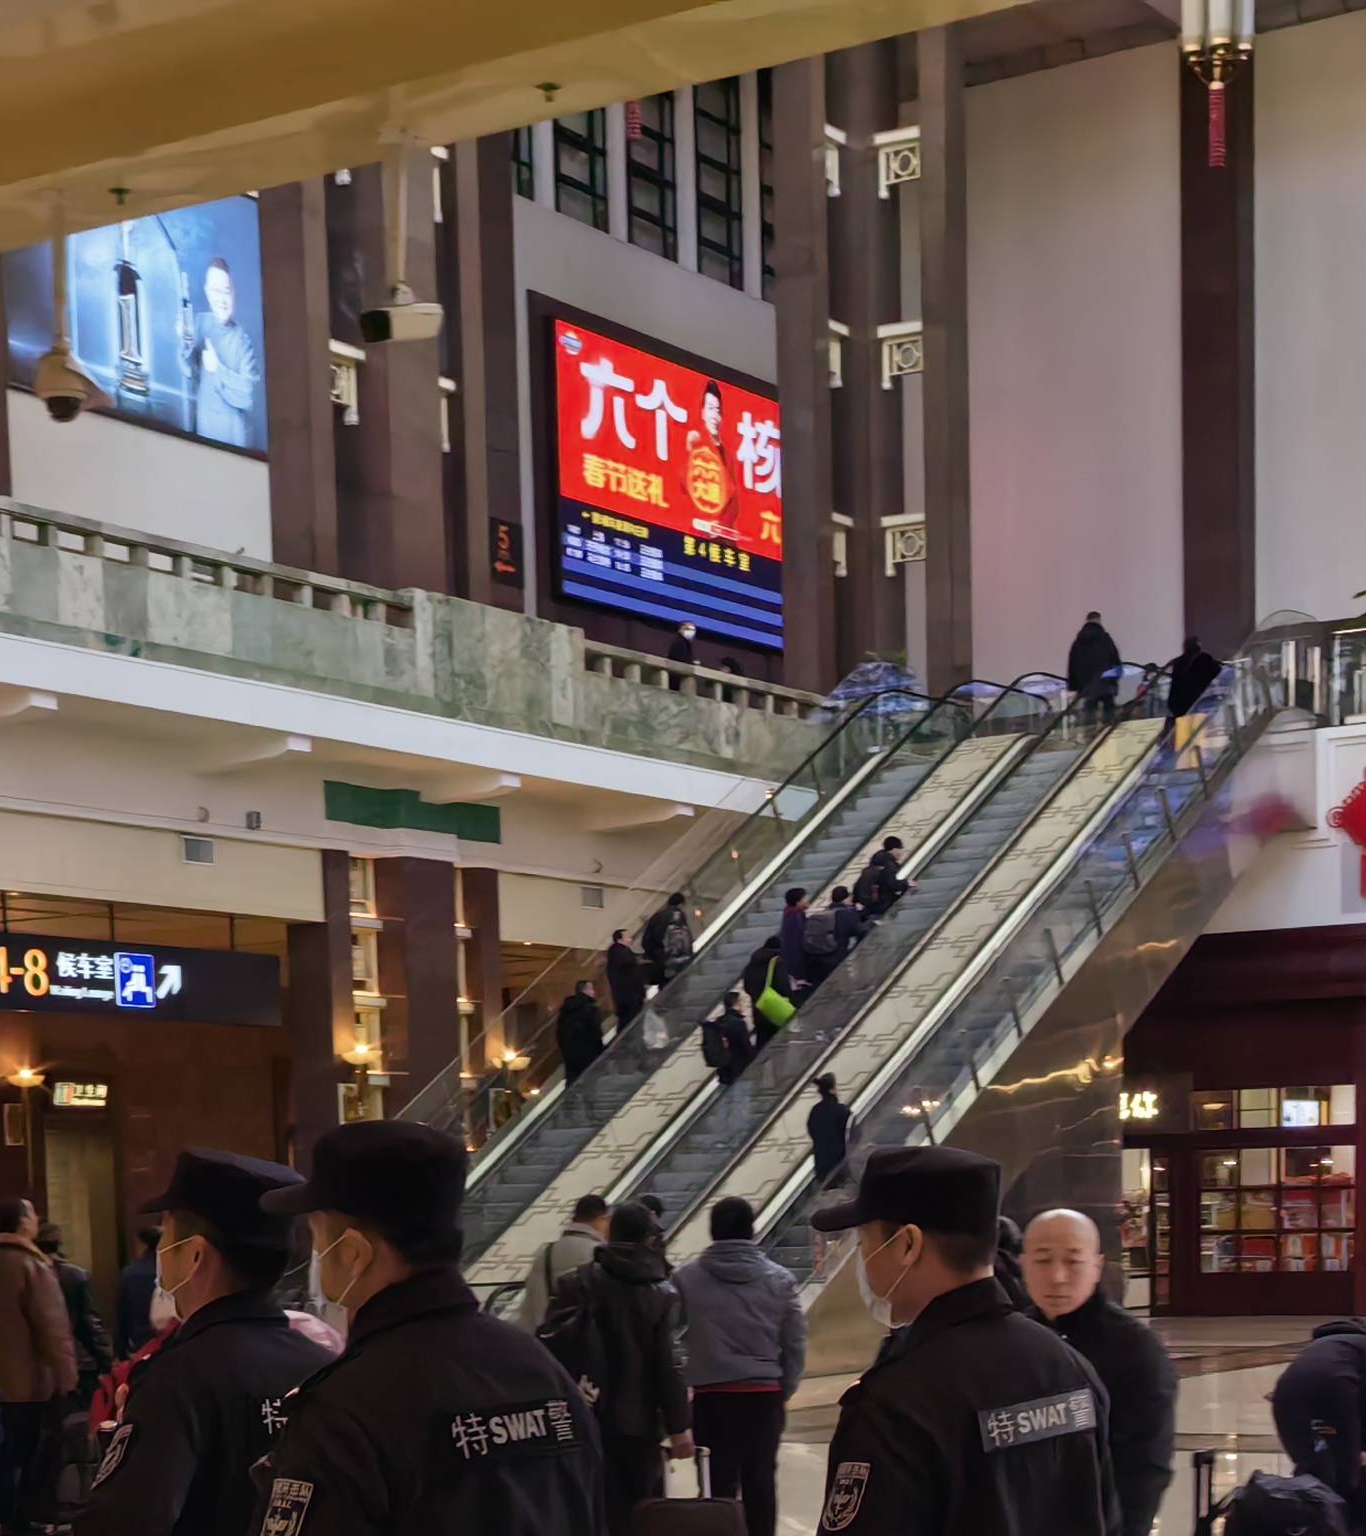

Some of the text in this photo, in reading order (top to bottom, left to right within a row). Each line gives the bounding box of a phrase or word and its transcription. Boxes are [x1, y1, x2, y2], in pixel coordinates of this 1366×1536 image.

[580, 357, 688, 462] 六个
[56, 951, 115, 980] 候车室
